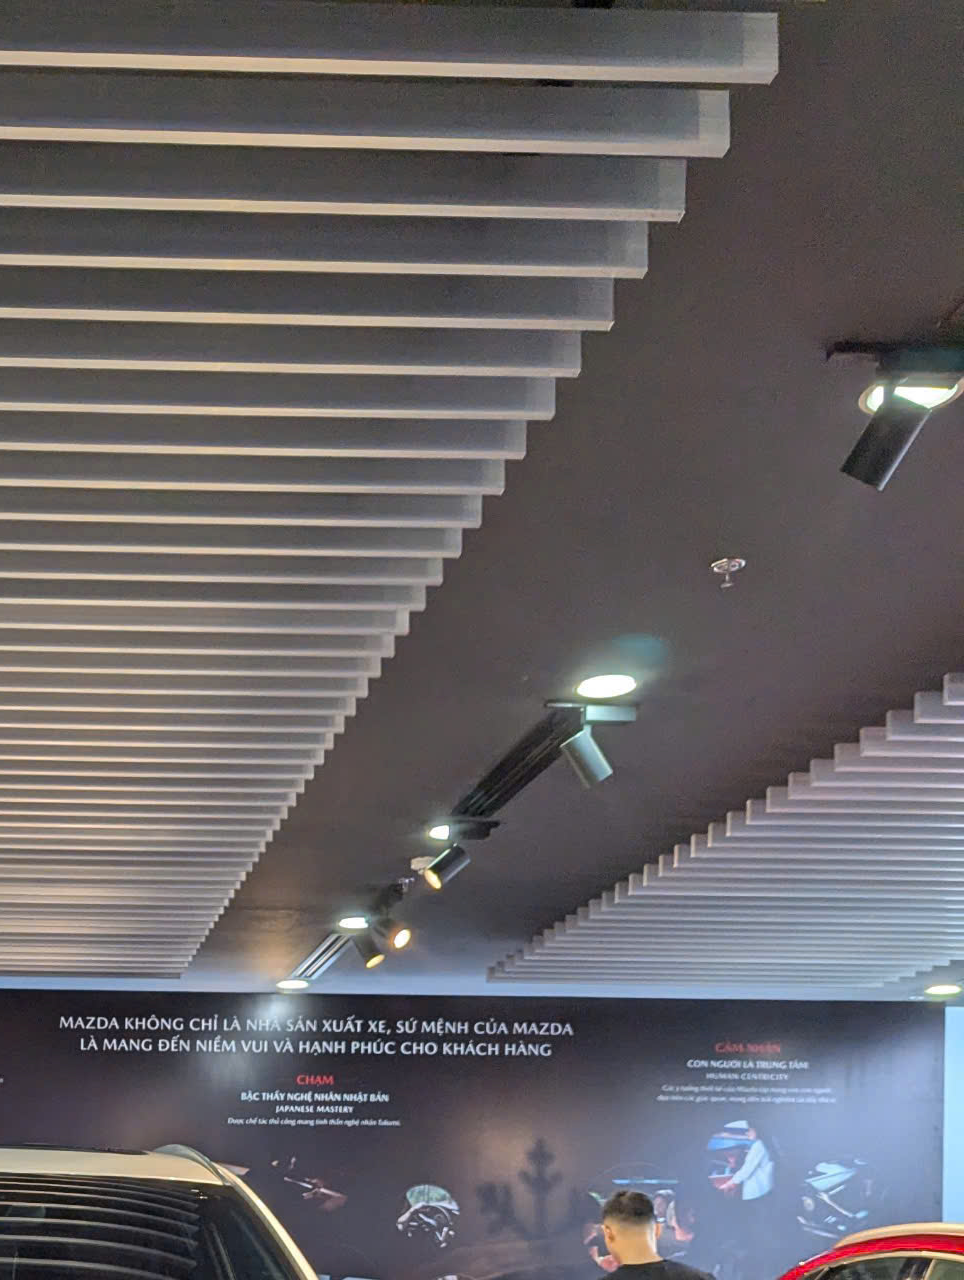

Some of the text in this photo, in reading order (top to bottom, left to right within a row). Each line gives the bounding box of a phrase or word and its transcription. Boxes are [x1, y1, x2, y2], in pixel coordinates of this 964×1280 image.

[59, 1014, 574, 1036] MAZDA KHÔNG CHỈ LÀ NHÀ SẢN XUẤT XE, SỨ MỆNH CỦA MAZDA
[80, 1034, 553, 1056] LÀ MANG ĐẾN NIỀM VUI VÀ HẠNH PHÚC CHO KHÁCH HÀNG
[687, 1059, 708, 1068] CON
[275, 1105, 354, 1113] JAPANESE MASTERY
